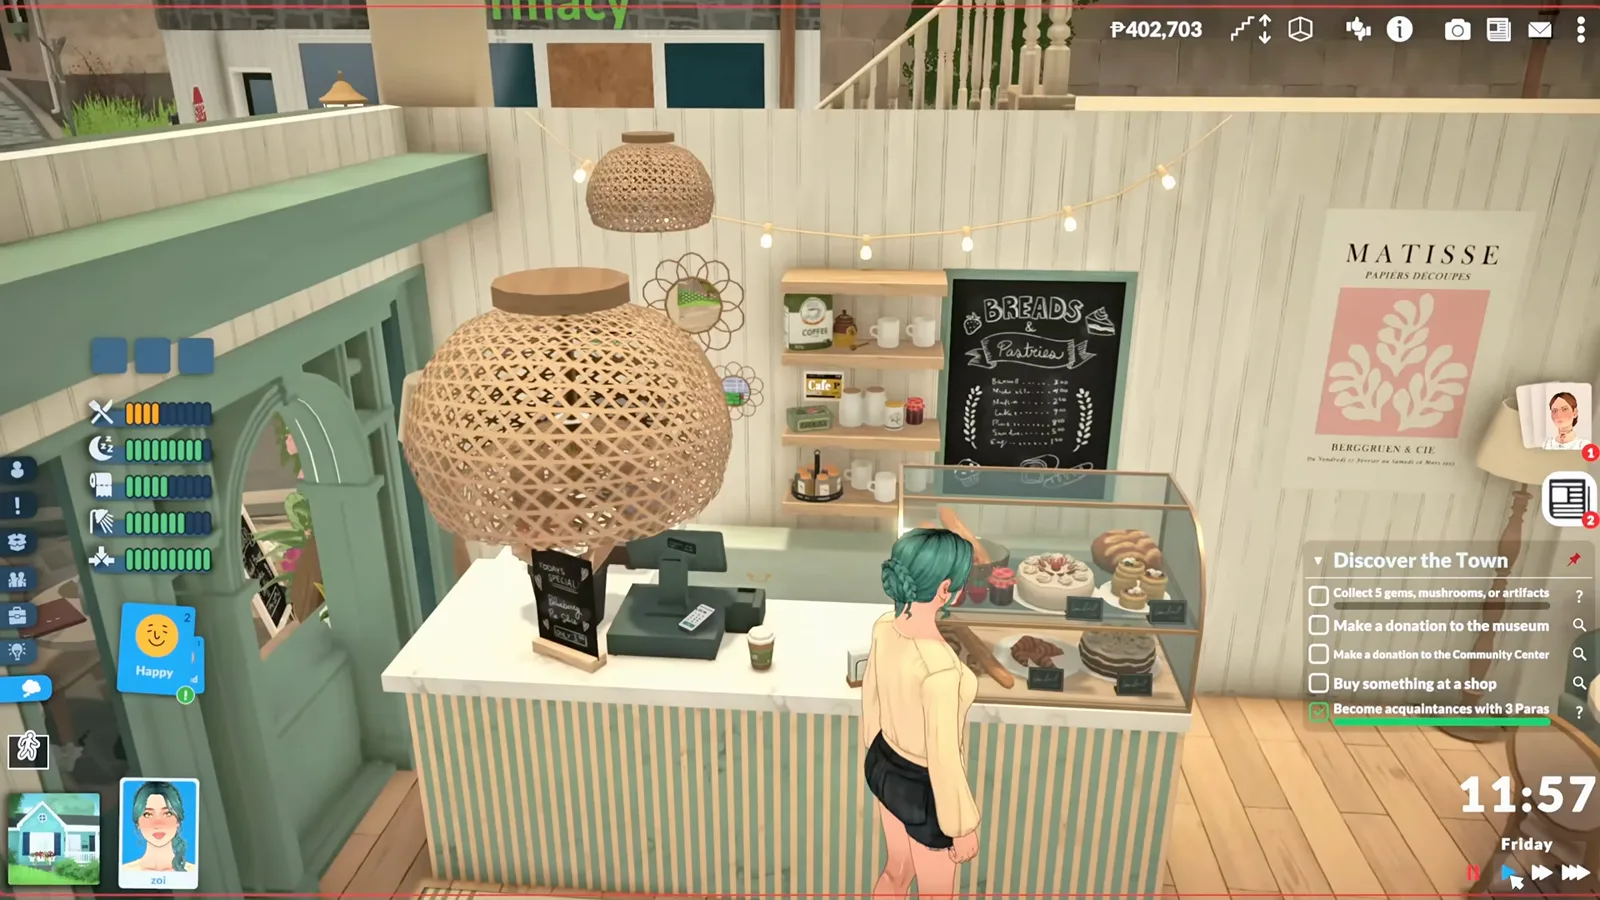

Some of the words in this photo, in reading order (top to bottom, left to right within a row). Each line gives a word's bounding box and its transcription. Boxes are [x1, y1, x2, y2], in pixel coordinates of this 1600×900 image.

[1346, 243, 1500, 265] MATISSE
[984, 295, 1085, 323] BREADS
[802, 327, 828, 337] COFFEE
[1024, 321, 1037, 333] &
[997, 340, 1065, 360] Pastries
[808, 379, 832, 391] Cafe
[1331, 443, 1402, 453] BERGGRUEN
[1404, 445, 1412, 454] &
[1416, 446, 1436, 455] CIE
